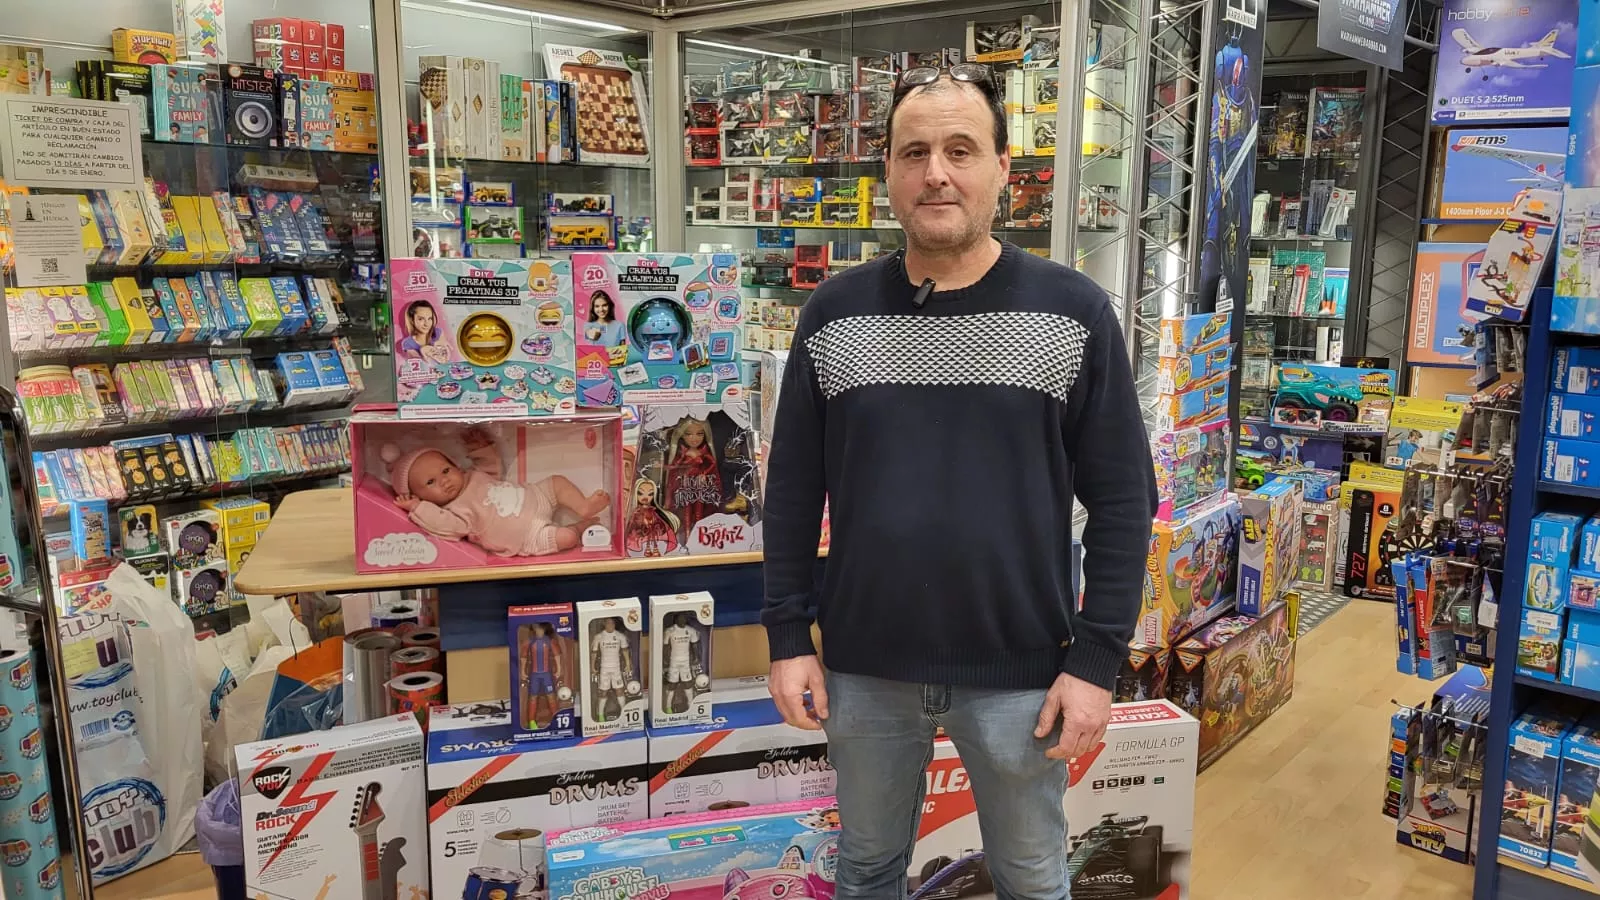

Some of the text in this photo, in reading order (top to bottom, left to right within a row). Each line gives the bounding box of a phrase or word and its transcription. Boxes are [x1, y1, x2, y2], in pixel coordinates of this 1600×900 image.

[1451, 96, 1474, 105] DUET
[31, 105, 108, 118] IMPRESCINDIBLE
[172, 111, 203, 122] FAMILY
[310, 106, 326, 120] TA
[55, 117, 83, 125] COMPRA
[303, 121, 331, 131] FAMILY
[93, 127, 121, 135] ESTADO
[43, 133, 84, 141] CUALQUIER
[86, 135, 113, 143] CAMBIO
[47, 141, 98, 150] RECLAMACIÓN
[16, 158, 51, 166] PASADOS
[92, 153, 124, 161] CAMBIOS
[586, 270, 604, 281] 20
[628, 267, 668, 275] CREA TUS
[411, 275, 427, 284] 30
[459, 277, 506, 287] CREA TUS
[620, 275, 677, 284] TARJETAS 3D
[448, 286, 518, 297] PEGATINAS 3D
[1415, 272, 1434, 348] MULTIPLEX
[411, 362, 420, 371] 2
[588, 361, 601, 369] 20
[1554, 350, 1566, 390] playmobil
[1360, 385, 1389, 394] TRUCKS
[1548, 395, 1560, 434] playmobil
[1544, 440, 1555, 479] playmobil
[1301, 501, 1332, 511] ARKING
[697, 525, 744, 549] BRATZ
[1351, 553, 1367, 578] 727
[1144, 615, 1158, 645] MARVEL
[697, 705, 705, 715] 6
[556, 716, 570, 729] 19
[625, 711, 639, 723] 10
[669, 715, 689, 723] Madrid
[599, 723, 620, 731] Madrid
[1115, 736, 1185, 752] FORMULA GP
[323, 762, 386, 779] ENHANCEMENT
[389, 755, 422, 767] SYSTEM
[255, 768, 290, 786] ROCK
[800, 778, 819, 786] DRUM
[549, 777, 639, 805] DRUMS
[800, 790, 825, 798] BATERÍA
[597, 804, 618, 812] DRUM
[255, 814, 296, 831] ROCK
[86, 807, 158, 869] club
[256, 831, 292, 843] GUITARRA
[257, 834, 309, 849] AMPLIFICADOR
[444, 841, 457, 858] 5
[1520, 844, 1543, 858] 70832
[576, 869, 643, 895] GABBY'S
